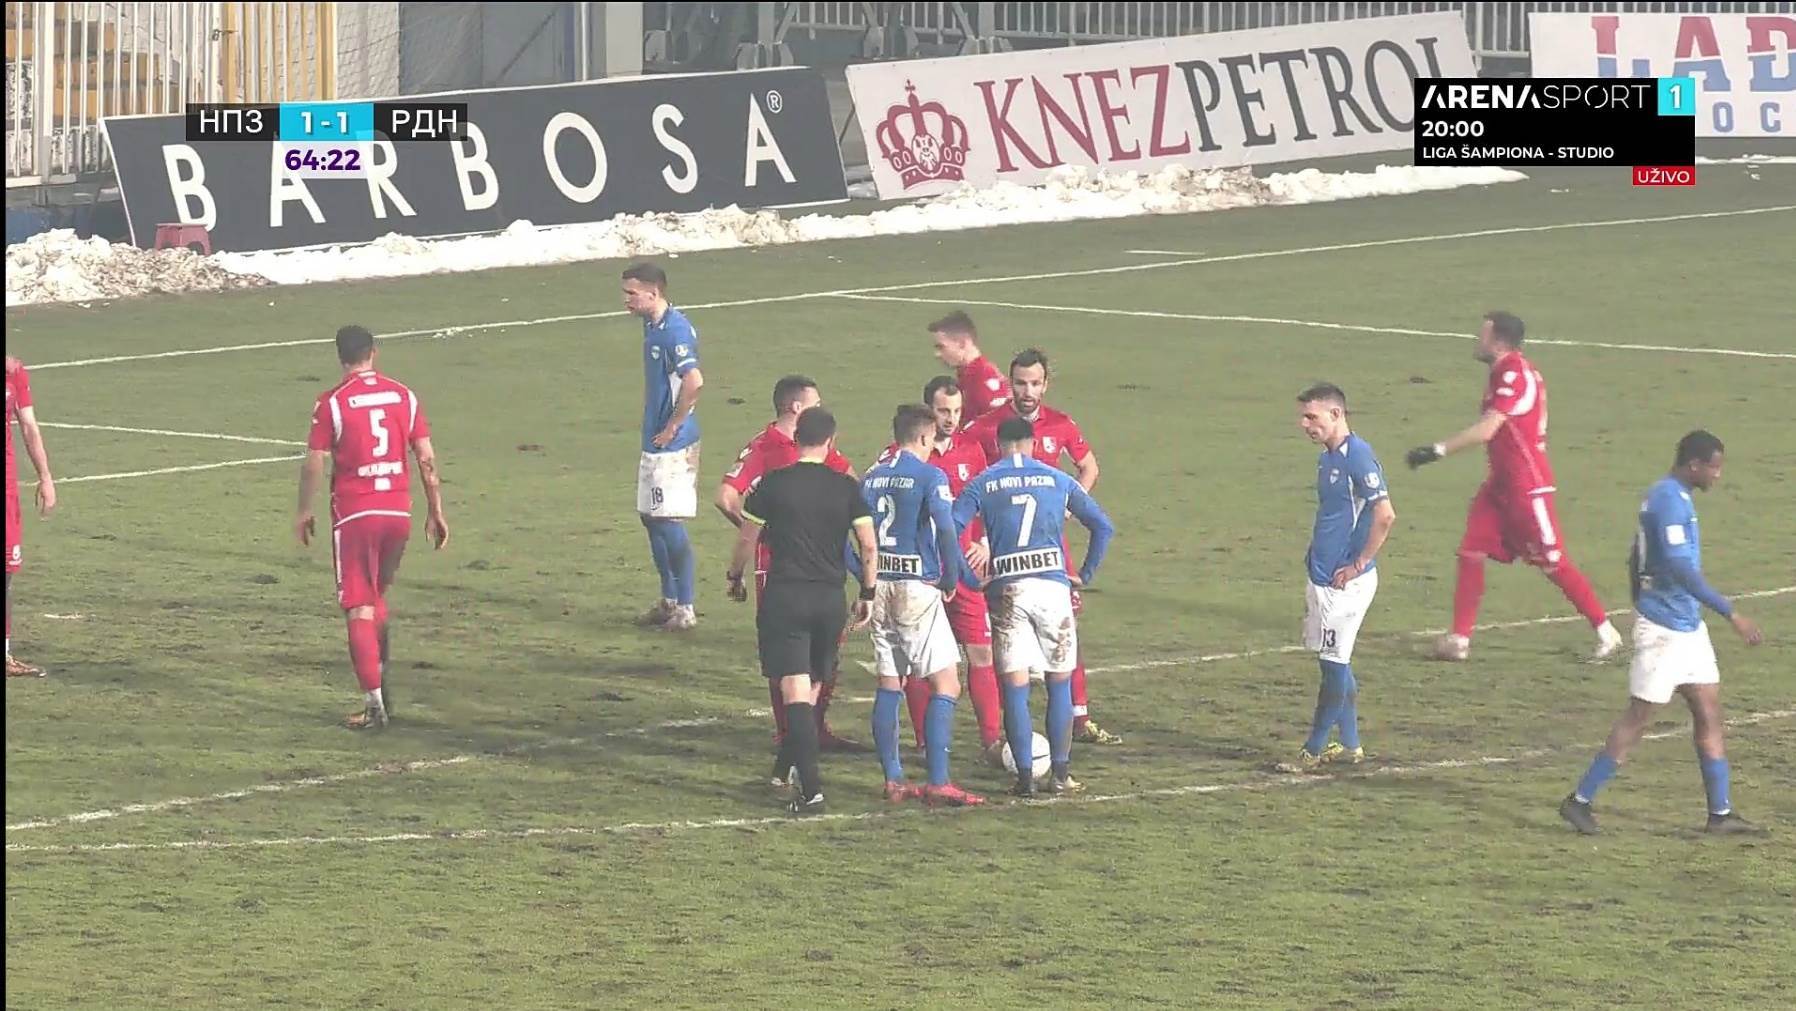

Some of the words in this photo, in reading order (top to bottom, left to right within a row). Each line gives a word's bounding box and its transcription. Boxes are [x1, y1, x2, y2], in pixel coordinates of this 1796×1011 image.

[369, 409, 389, 457] 5
[986, 480, 999, 493] FK
[1000, 476, 1022, 489] NOVI
[651, 487, 664, 505] 18
[877, 494, 897, 546] 2
[1011, 494, 1037, 547] 7
[877, 554, 920, 574] INBET
[996, 552, 1059, 575] WINBET
[1322, 628, 1336, 648] 13
